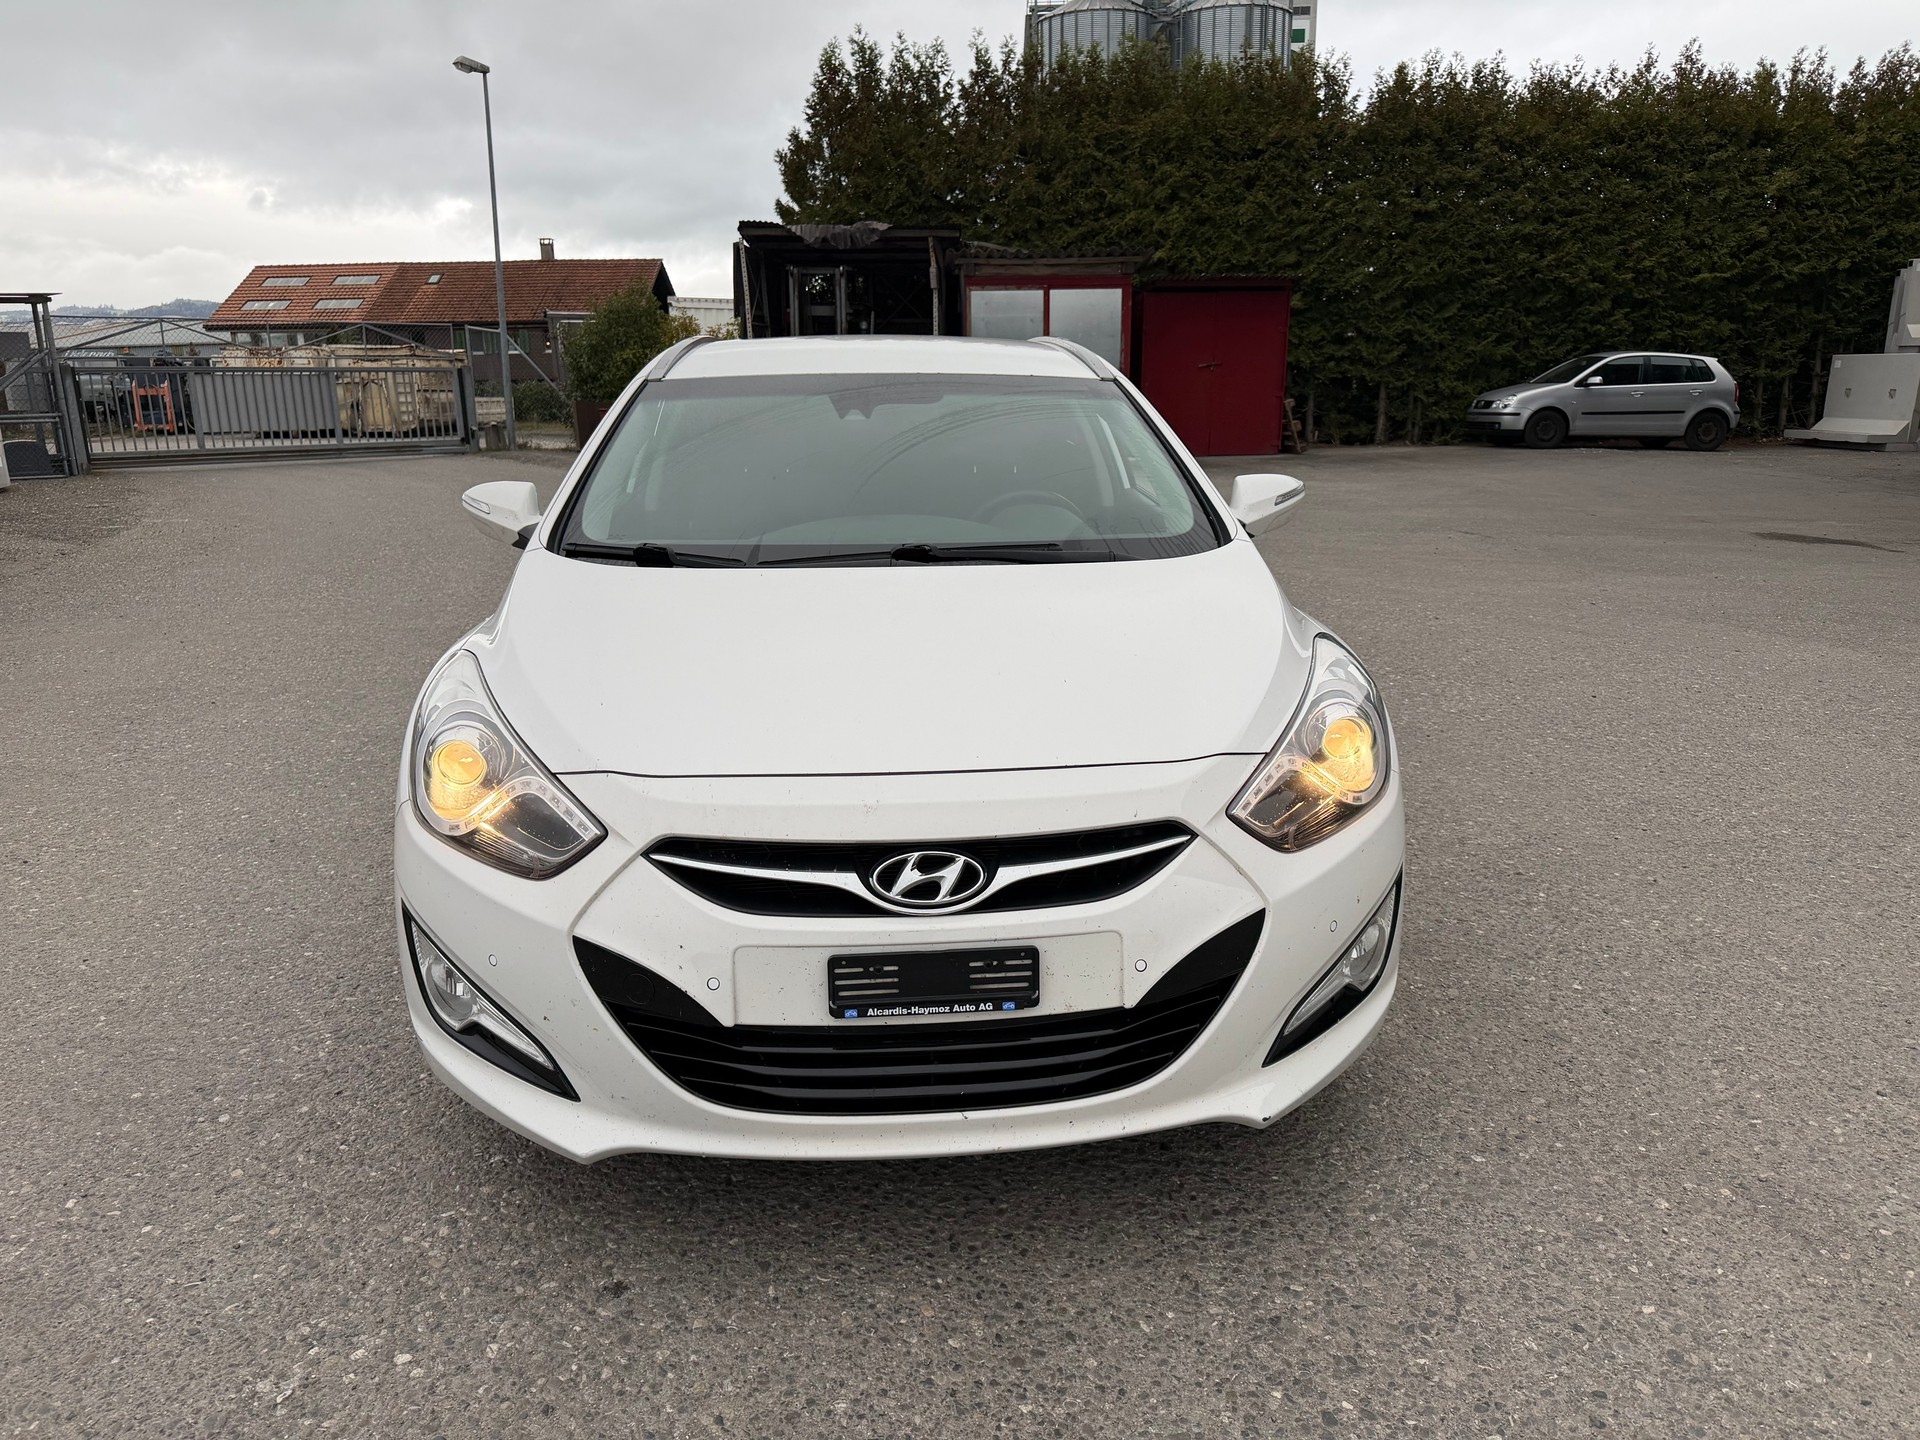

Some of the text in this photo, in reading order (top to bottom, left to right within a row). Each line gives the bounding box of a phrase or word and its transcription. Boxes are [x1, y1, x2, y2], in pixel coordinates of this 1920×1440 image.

[867, 1002, 993, 1016] Alcardis-Haymoz Auto AG
